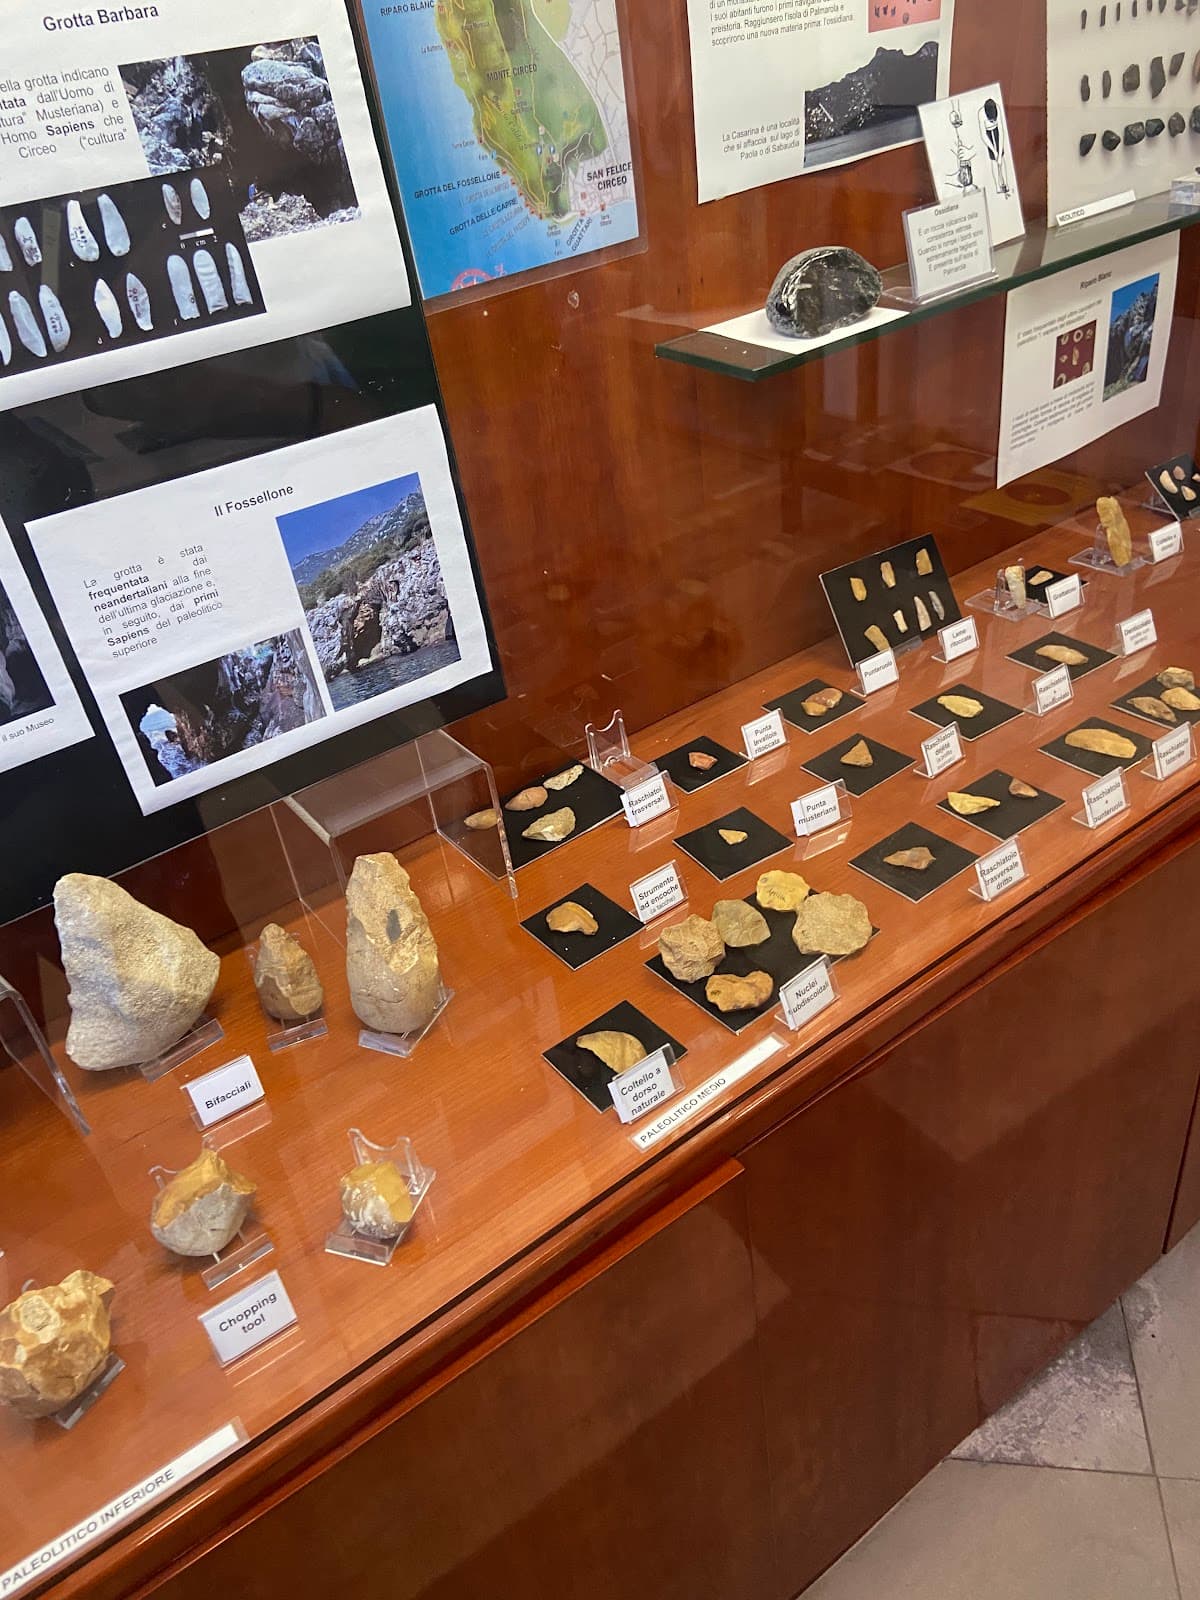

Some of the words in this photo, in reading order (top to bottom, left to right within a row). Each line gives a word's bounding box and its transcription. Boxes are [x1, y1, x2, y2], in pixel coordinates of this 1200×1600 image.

[43, 14, 94, 31] Grotta
[97, 6, 159, 24] Barbara
[380, 5, 408, 16] RIPARO
[730, 7, 752, 18] abitanti
[754, 5, 773, 13] furono
[779, 2, 793, 12] primi
[744, 15, 783, 29] Raggiunsero
[803, 9, 809, 18] di
[810, 4, 838, 16] Palmarola
[712, 34, 745, 47] scoprirono
[747, 31, 758, 40] una
[760, 27, 779, 37] nuova
[780, 23, 803, 33] materia
[25, 74, 58, 91] grotta
[60, 67, 109, 83] indicano
[487, 69, 511, 81] MONTE
[513, 64, 537, 76] CIRCEO
[37, 86, 94, 104] dall'Uomo
[104, 81, 115, 93] di
[36, 99, 104, 121] Musteriana)
[111, 99, 119, 109] e
[1, 130, 37, 145] Homo
[46, 120, 95, 137] Sapiens
[103, 115, 124, 127] che
[722, 134, 730, 142] La
[732, 127, 759, 140] Casarina
[767, 123, 778, 131] una
[723, 145, 735, 153] che
[770, 133, 779, 142] sul
[780, 131, 793, 141] lago
[795, 128, 800, 136] di
[18, 144, 57, 159] Circeo
[740, 150, 758, 160] Paola
[765, 146, 770, 154] di
[772, 140, 800, 152] Sabaudia
[414, 187, 442, 199] GROTTA
[443, 182, 455, 192] DEL
[457, 171, 500, 188] FOSSELLONE
[587, 170, 604, 182] SAN
[598, 175, 627, 191] CIRCEO
[449, 218, 476, 235] GROTTA
[476, 209, 496, 222] DELLE
[497, 198, 518, 212] CAPRE
[566, 218, 585, 246] GROTTA
[571, 217, 593, 251] GUATTARI
[214, 505, 223, 517] Il
[225, 486, 294, 514] Fossellone
[83, 579, 97, 589] La
[113, 564, 143, 580] grotta
[158, 556, 165, 564] è
[180, 544, 204, 558] stata
[88, 575, 149, 600] frequentata
[192, 555, 208, 567] dai
[94, 580, 168, 612] neandertaliani
[172, 575, 190, 587] alla
[193, 567, 211, 579] fine
[98, 602, 148, 624] dell'ultima
[150, 583, 203, 608] glaciazione
[102, 627, 113, 636] in
[122, 611, 161, 629] seguito,
[169, 601, 185, 613] dai
[193, 589, 219, 606] primi
[107, 626, 150, 647] Sapiens
[155, 619, 171, 630] del
[177, 601, 223, 624] paleolitico
[112, 637, 158, 659] superiore
[9, 729, 25, 740] suo
[25, 718, 55, 732] Museo
[755, 725, 772, 736] Punta
[628, 786, 662, 808] Raschiatoi
[631, 794, 665, 816] trasversali
[1087, 782, 1121, 805] Raschiatoio
[798, 805, 837, 824] musteriana
[806, 800, 826, 812] Punta
[980, 851, 1017, 877] Raschiatoio
[985, 861, 1019, 886] trasversale
[638, 876, 674, 900] Strumento
[996, 876, 1013, 890] dritto
[640, 901, 650, 911] ad
[651, 884, 678, 904] encoche
[795, 978, 818, 999] Nuclei
[620, 1072, 654, 1096] Coltello
[655, 1067, 661, 1075] a
[632, 1082, 658, 1102] dorso
[205, 1080, 252, 1109] Bifacciali
[631, 1090, 666, 1116] naturale
[640, 1098, 698, 1143] PALEOLITICO
[697, 1078, 726, 1101] MEDIO
[218, 1292, 277, 1332] Chopping
[241, 1314, 266, 1334] tool
[2, 1521, 98, 1590] PALEOLITICO
[100, 1468, 175, 1525] INFERIORE
